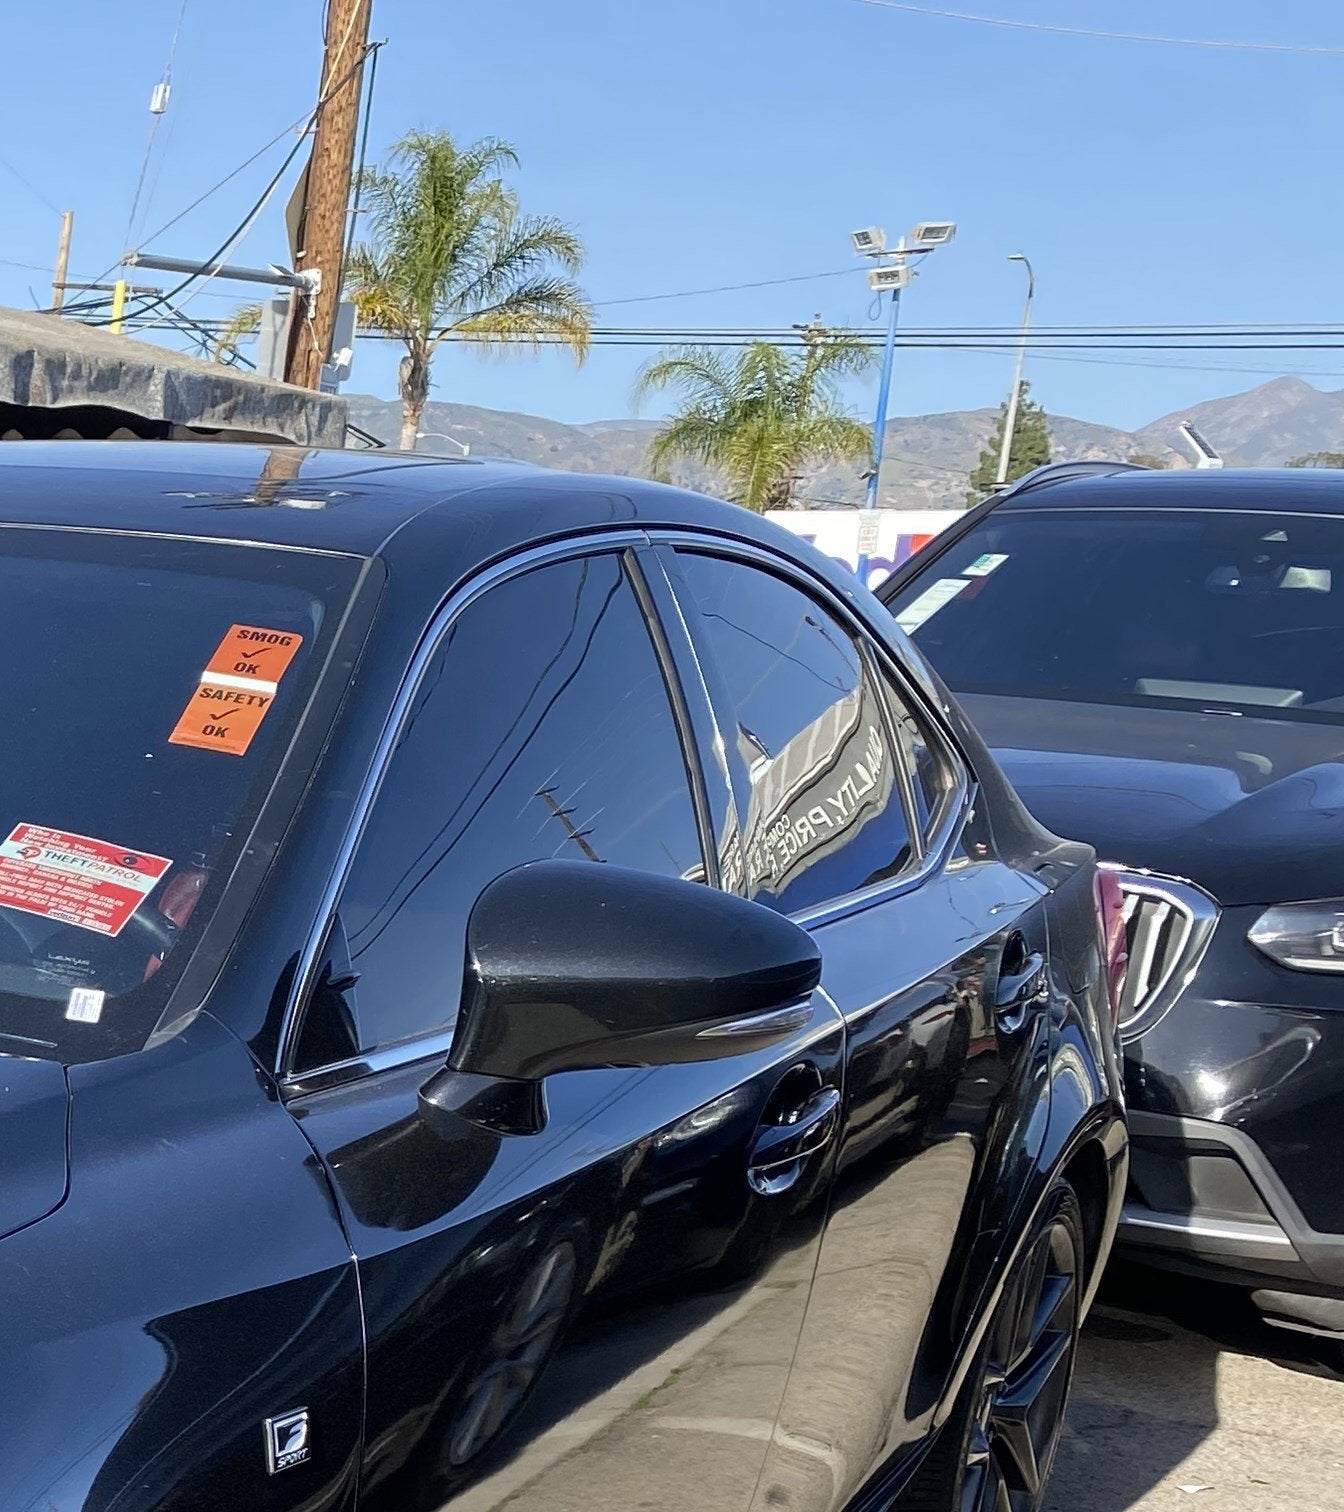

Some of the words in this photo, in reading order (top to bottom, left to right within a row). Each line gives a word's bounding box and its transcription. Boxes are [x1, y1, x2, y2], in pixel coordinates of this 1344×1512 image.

[237, 629, 293, 647] SMOG
[233, 662, 260, 675] OK
[199, 687, 271, 708] SAFETY
[202, 724, 230, 738] OK
[27, 827, 51, 837] Who
[24, 833, 71, 849] Watching
[74, 842, 98, 853] Your
[276, 1447, 309, 1469] SPORT
